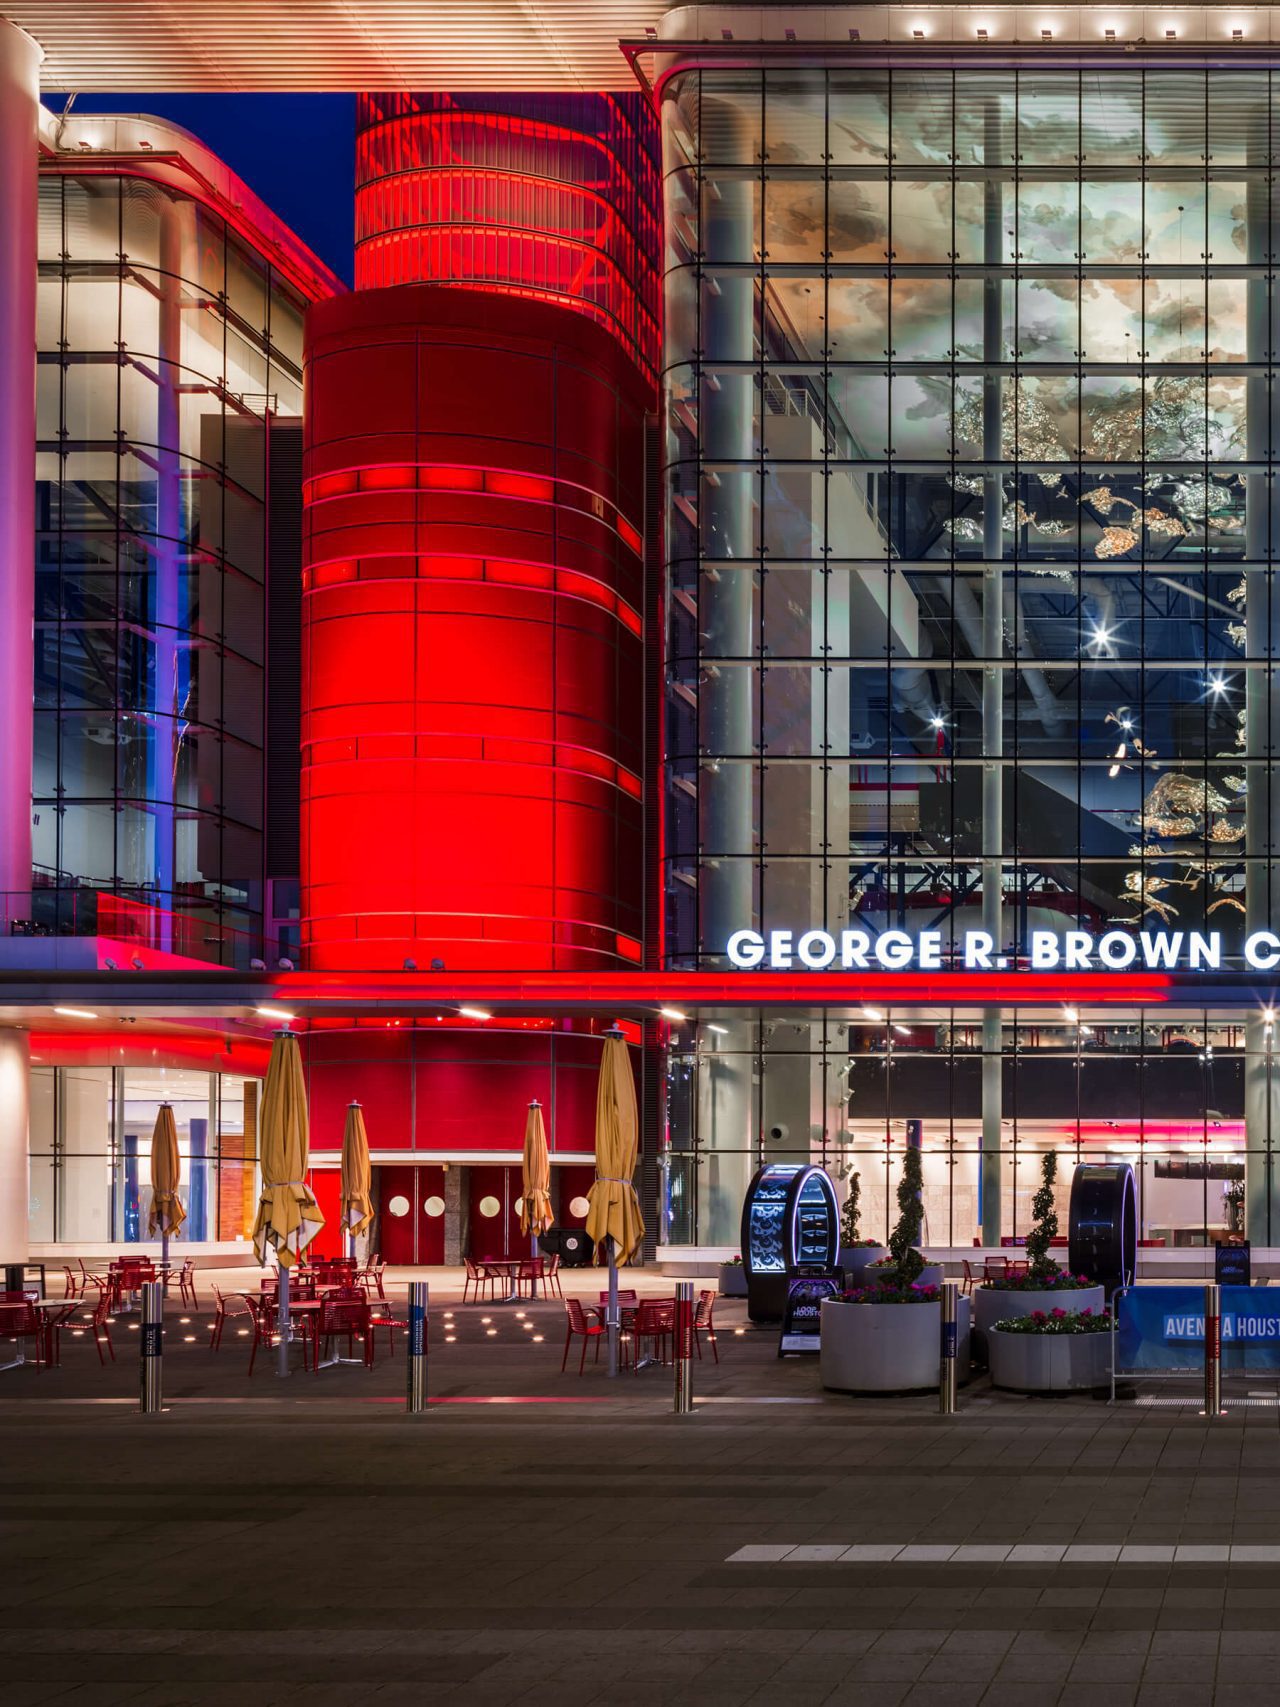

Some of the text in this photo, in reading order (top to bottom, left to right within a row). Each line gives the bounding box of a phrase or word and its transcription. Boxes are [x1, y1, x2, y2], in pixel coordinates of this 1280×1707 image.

[727, 929, 942, 969] GEORGE
[965, 931, 1008, 968] R.
[1031, 931, 1221, 969] BROWN
[1166, 1316, 1233, 1337] AVENA
